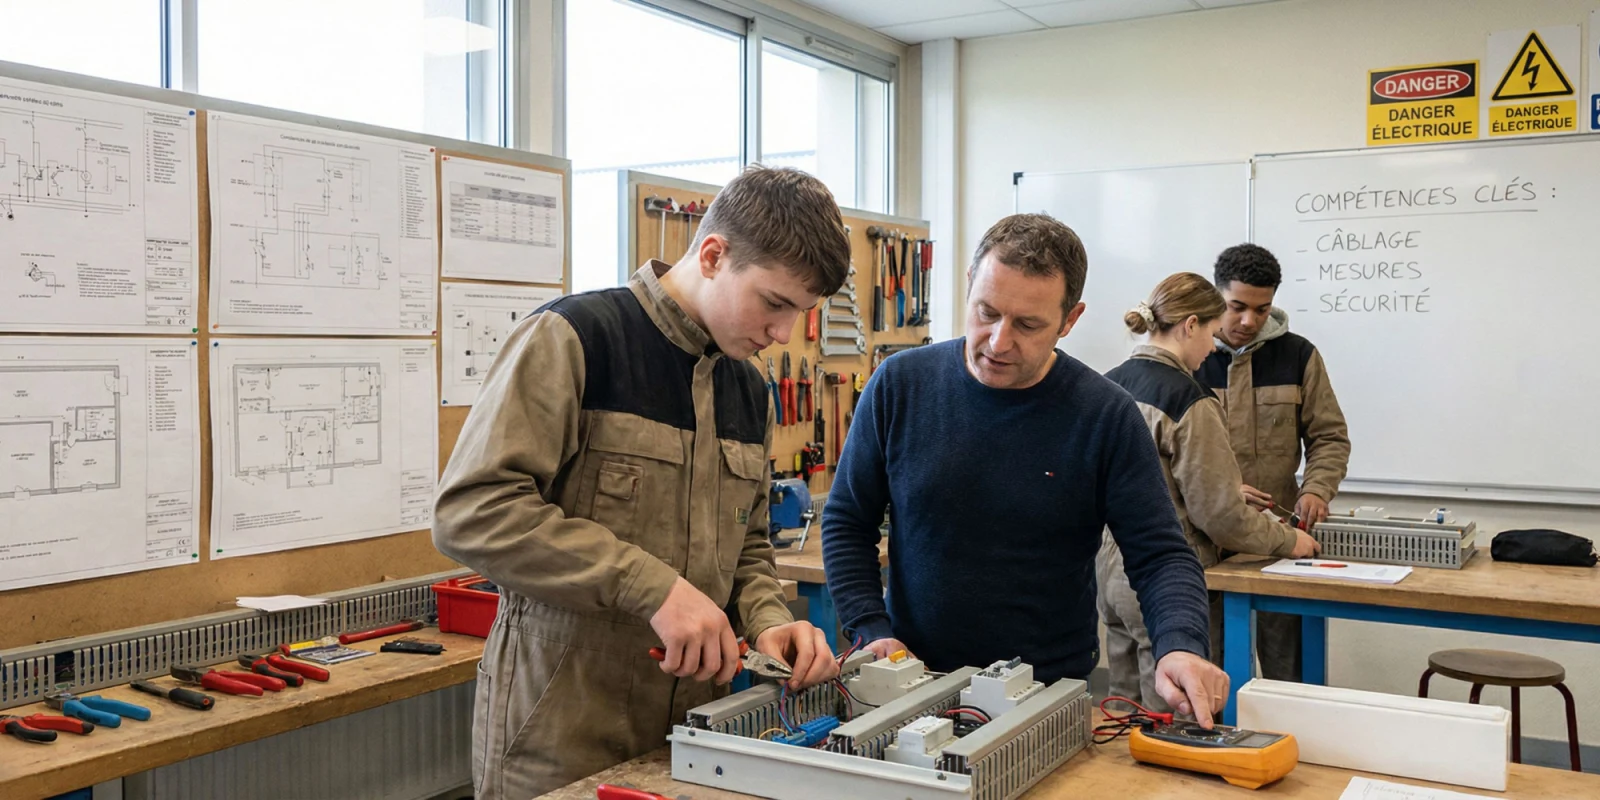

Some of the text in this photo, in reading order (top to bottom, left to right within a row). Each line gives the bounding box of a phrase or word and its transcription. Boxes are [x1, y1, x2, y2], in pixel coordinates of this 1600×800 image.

[1385, 75, 1460, 95] DANGER
[1389, 105, 1455, 121] DANGER
[1505, 104, 1559, 119] DANGER
[1372, 121, 1472, 140] ÉLECTRIQUE
[1492, 117, 1573, 133] ÉLECTRIQUE
[1295, 185, 1457, 214] COMPÉTENCES
[1474, 176, 1537, 203] CLÉS
[1316, 227, 1422, 252] CÂBLAGE
[1319, 260, 1423, 282] MESURES
